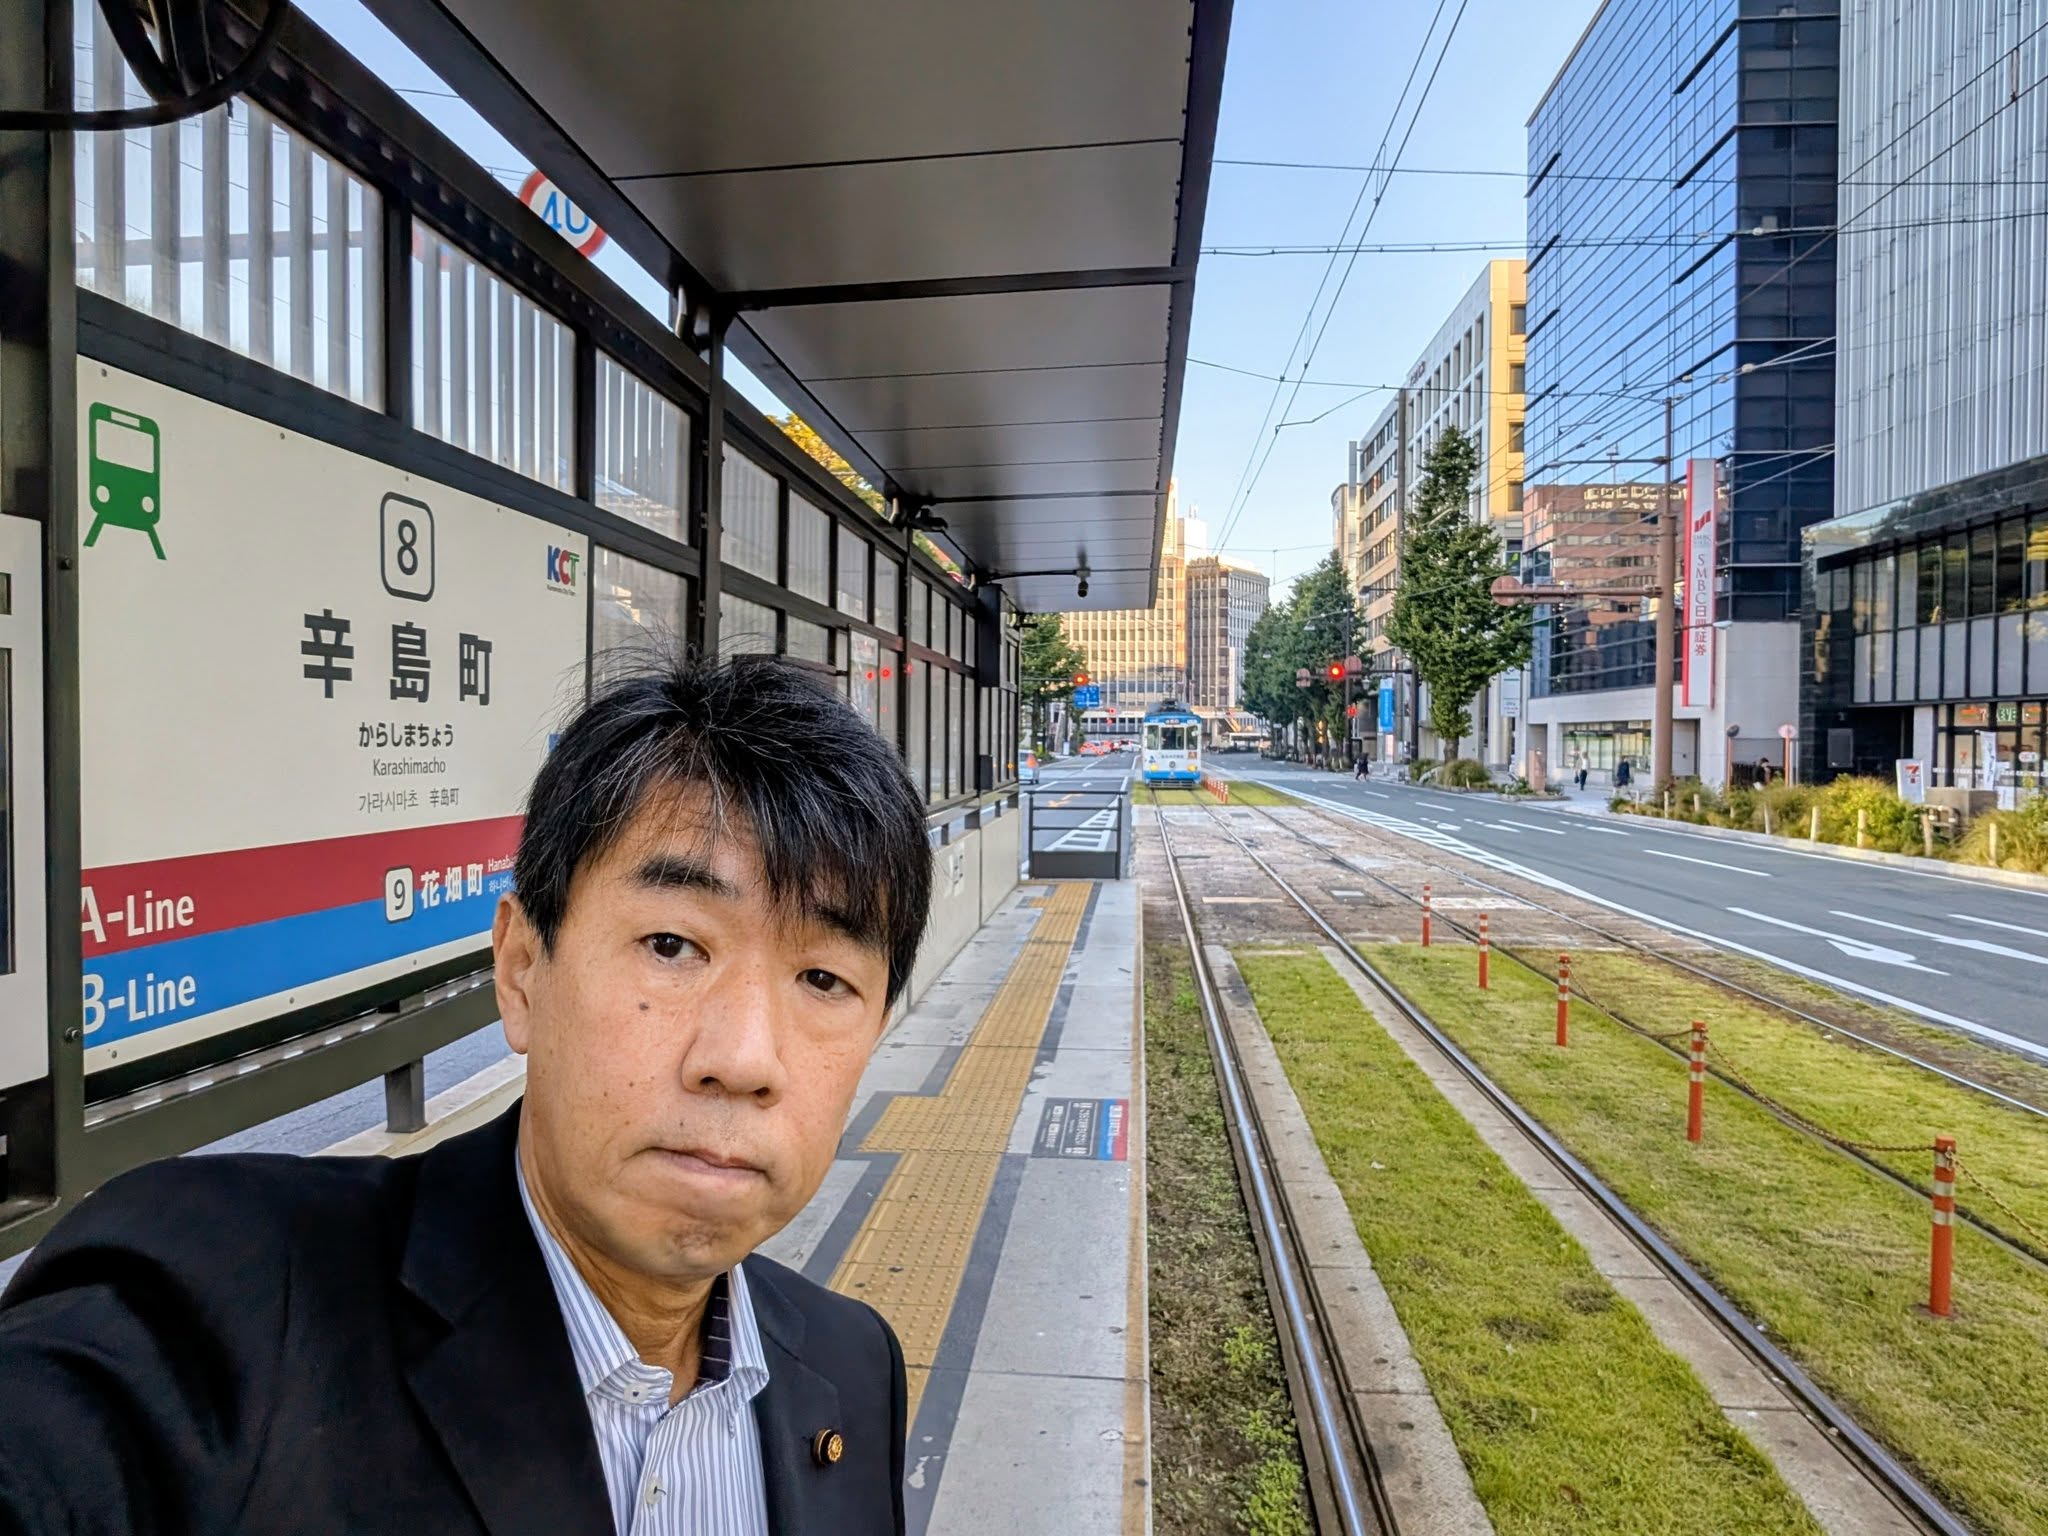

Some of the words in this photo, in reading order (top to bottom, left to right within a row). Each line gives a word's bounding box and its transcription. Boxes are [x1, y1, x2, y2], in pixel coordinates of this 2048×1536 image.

[397, 519, 418, 576] 8
[547, 545, 579, 586] KCT
[301, 608, 492, 706] 辛島町
[358, 722, 453, 747] からしまちょう
[373, 756, 446, 776] Karashimacho
[359, 790, 419, 813] 가라시마초
[393, 879, 406, 911] 9
[420, 863, 484, 909] 花畑町
[81, 886, 195, 943] A-Line
[83, 972, 197, 1035] B-Line
